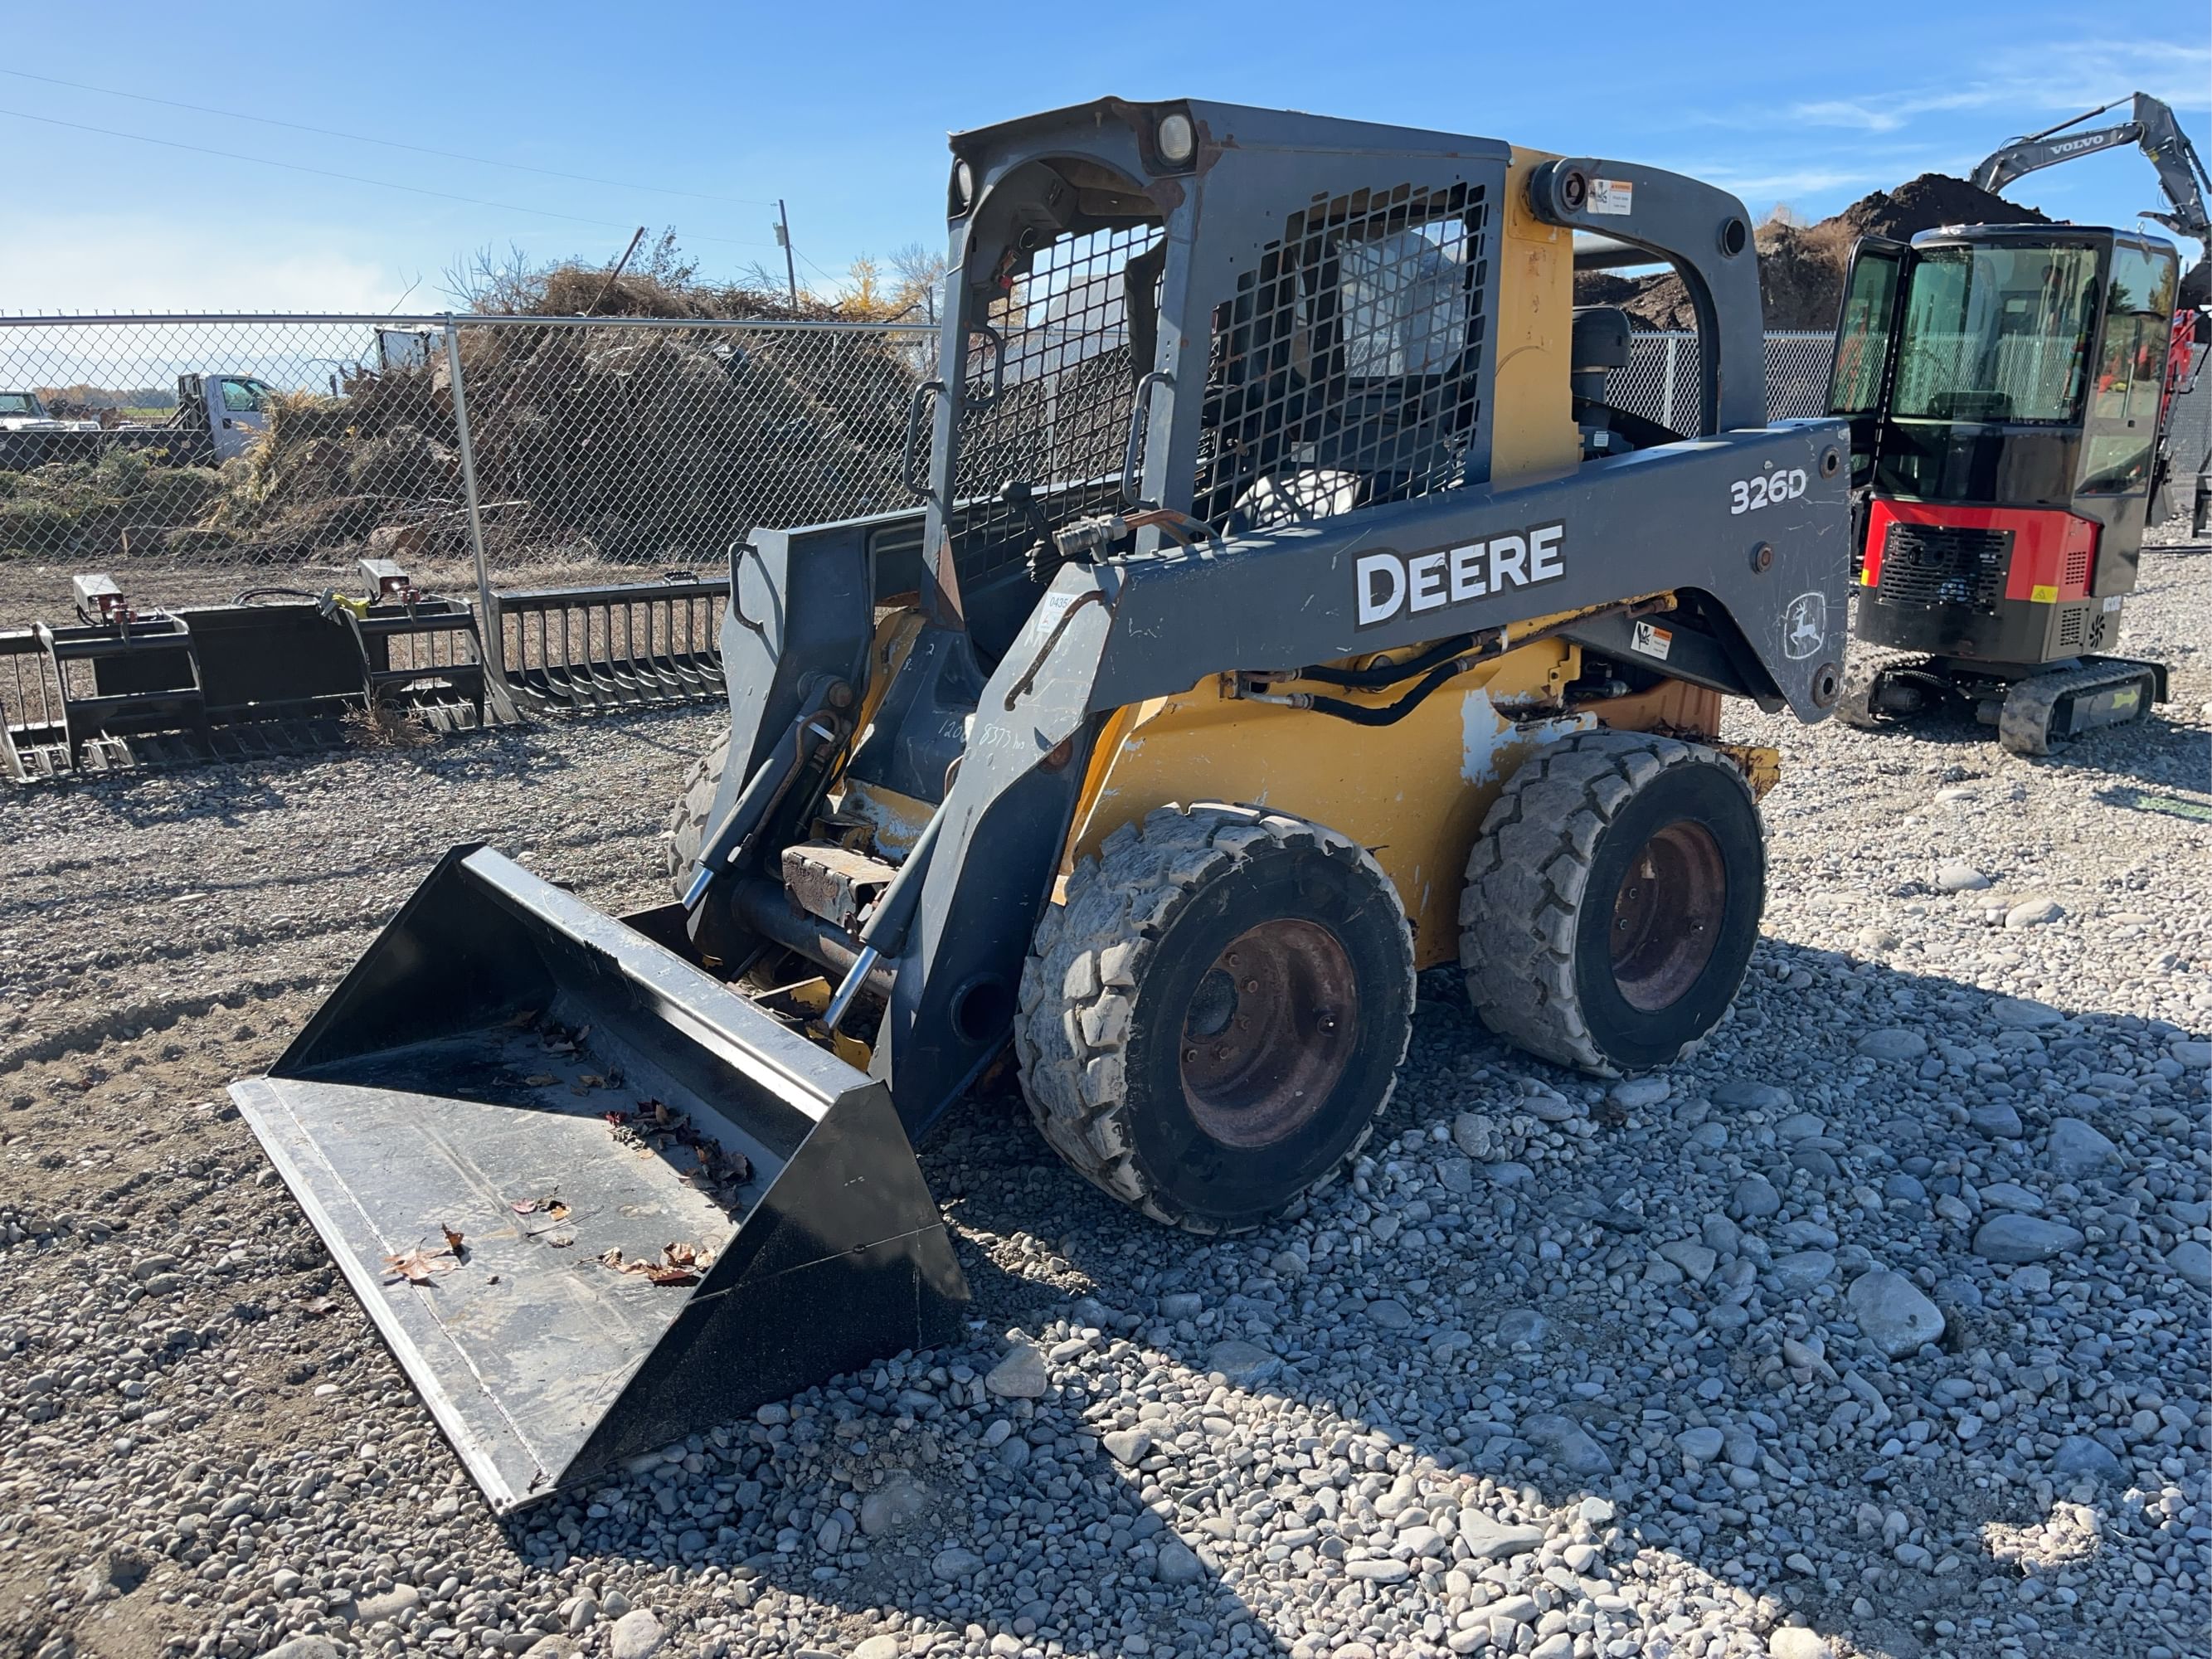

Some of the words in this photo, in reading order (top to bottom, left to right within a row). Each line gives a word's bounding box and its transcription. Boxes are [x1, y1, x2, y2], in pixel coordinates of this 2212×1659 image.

[2050, 135, 2104, 154] VOLVO
[1730, 469, 1806, 515] 326D
[1356, 524, 1563, 625] DEERE
